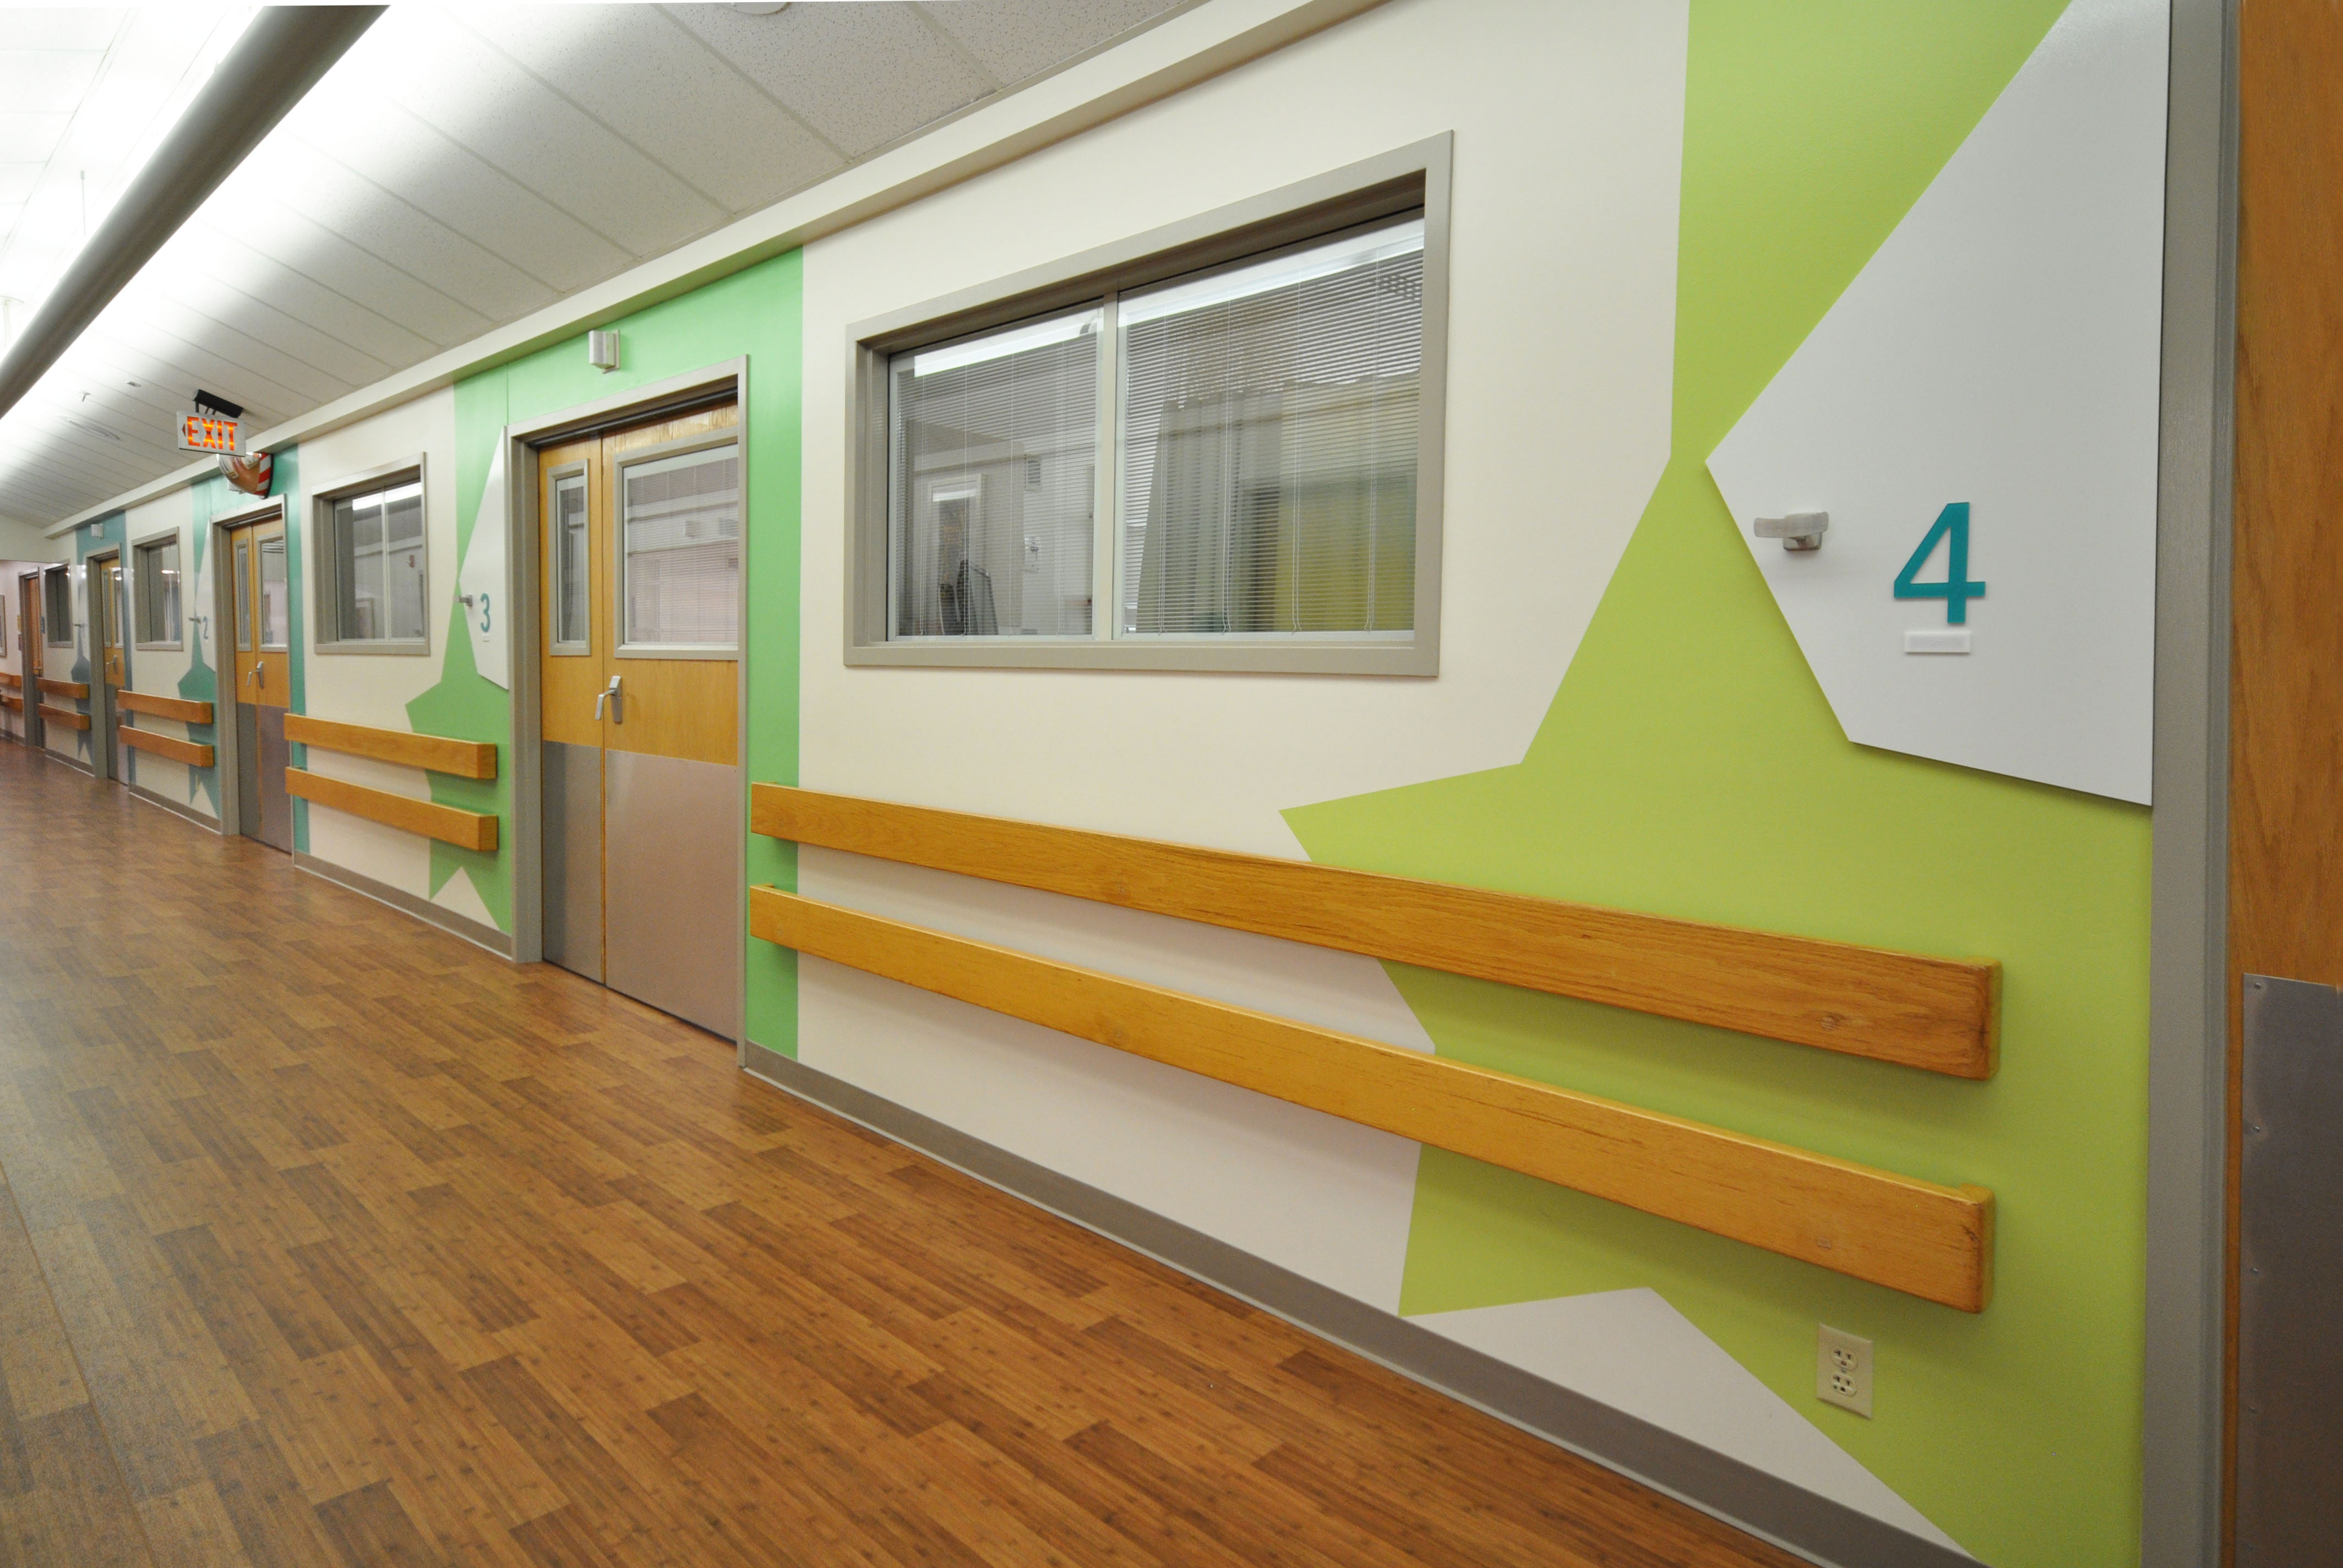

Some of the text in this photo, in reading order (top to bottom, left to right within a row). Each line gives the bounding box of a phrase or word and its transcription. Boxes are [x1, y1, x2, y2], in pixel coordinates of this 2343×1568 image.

[186, 416, 238, 451] EXIT
[1894, 502, 1986, 624] 4
[480, 592, 491, 633] 3
